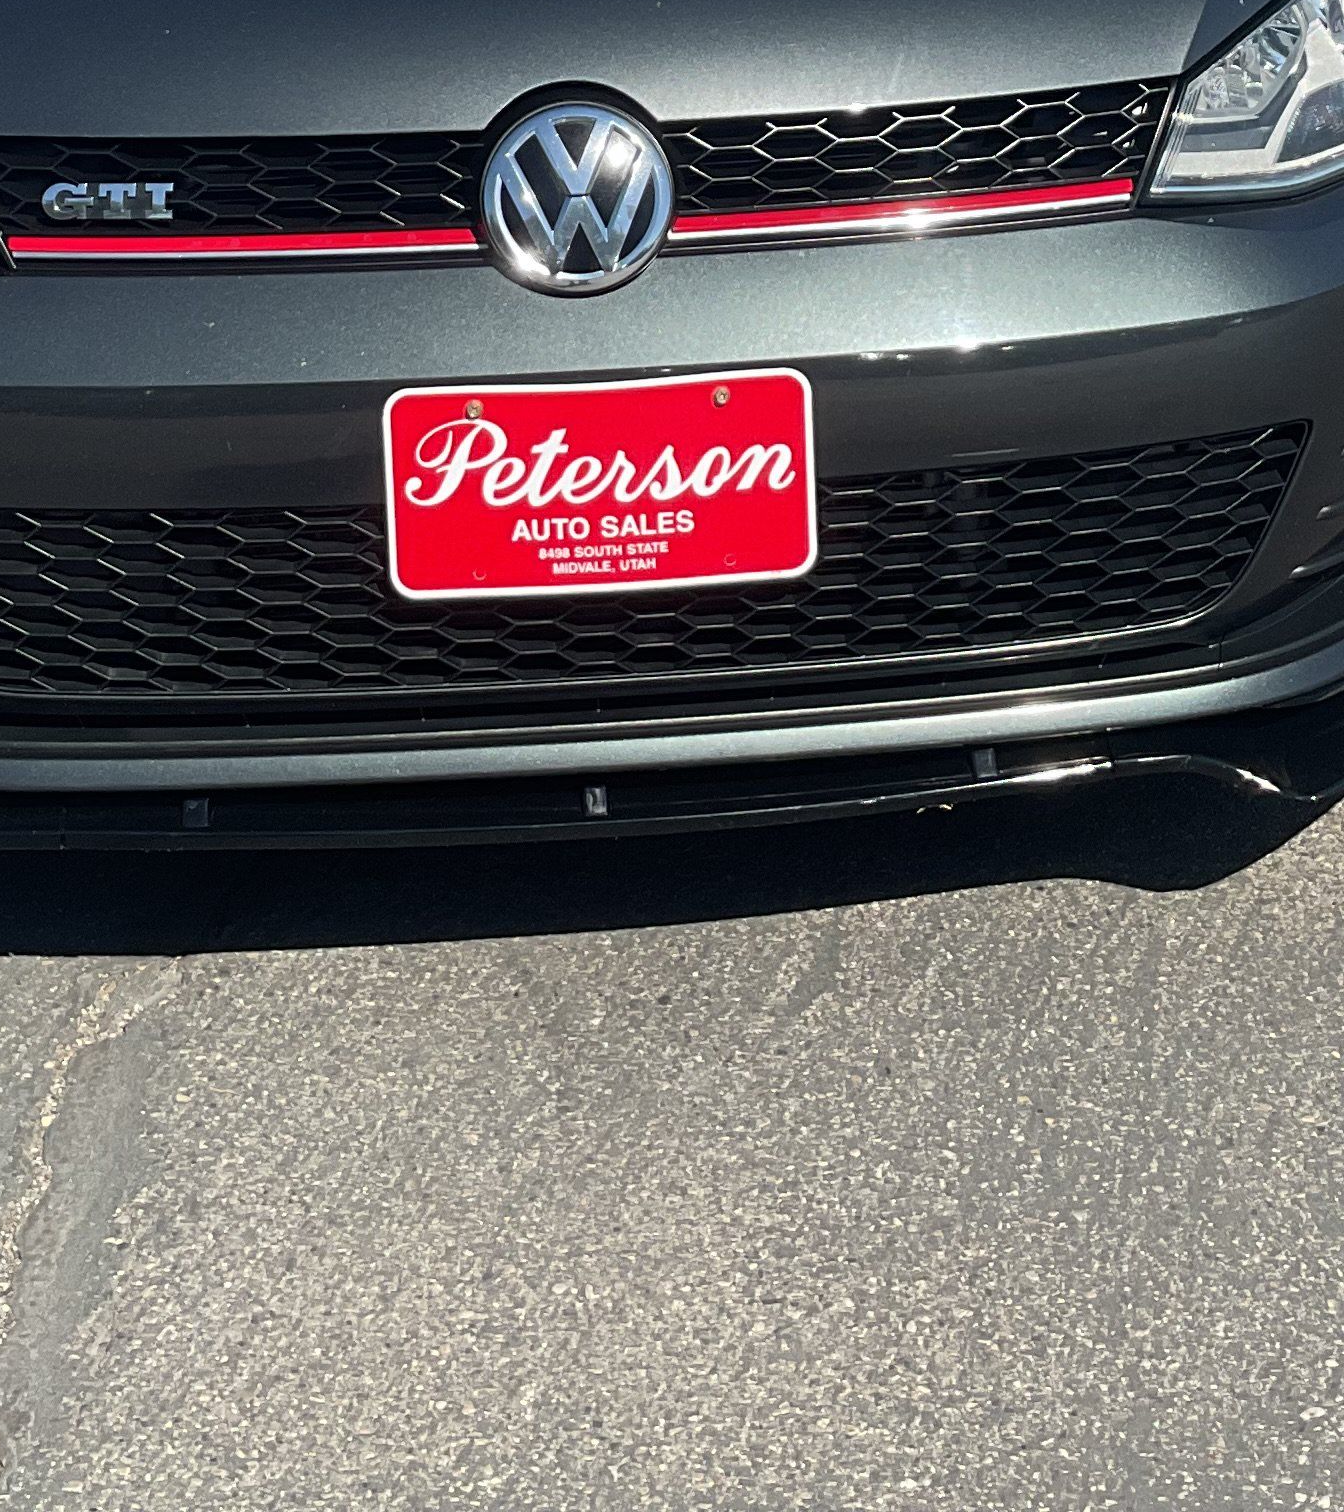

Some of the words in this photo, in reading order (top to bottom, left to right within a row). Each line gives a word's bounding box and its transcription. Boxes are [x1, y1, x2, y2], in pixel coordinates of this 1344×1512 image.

[41, 182, 174, 220] GTI
[405, 418, 796, 508] Peterson
[511, 516, 590, 542] AUTO
[600, 509, 695, 538] SALES
[574, 545, 623, 558] SOUTH
[627, 541, 669, 555] STATE
[619, 557, 656, 571] UTAH
